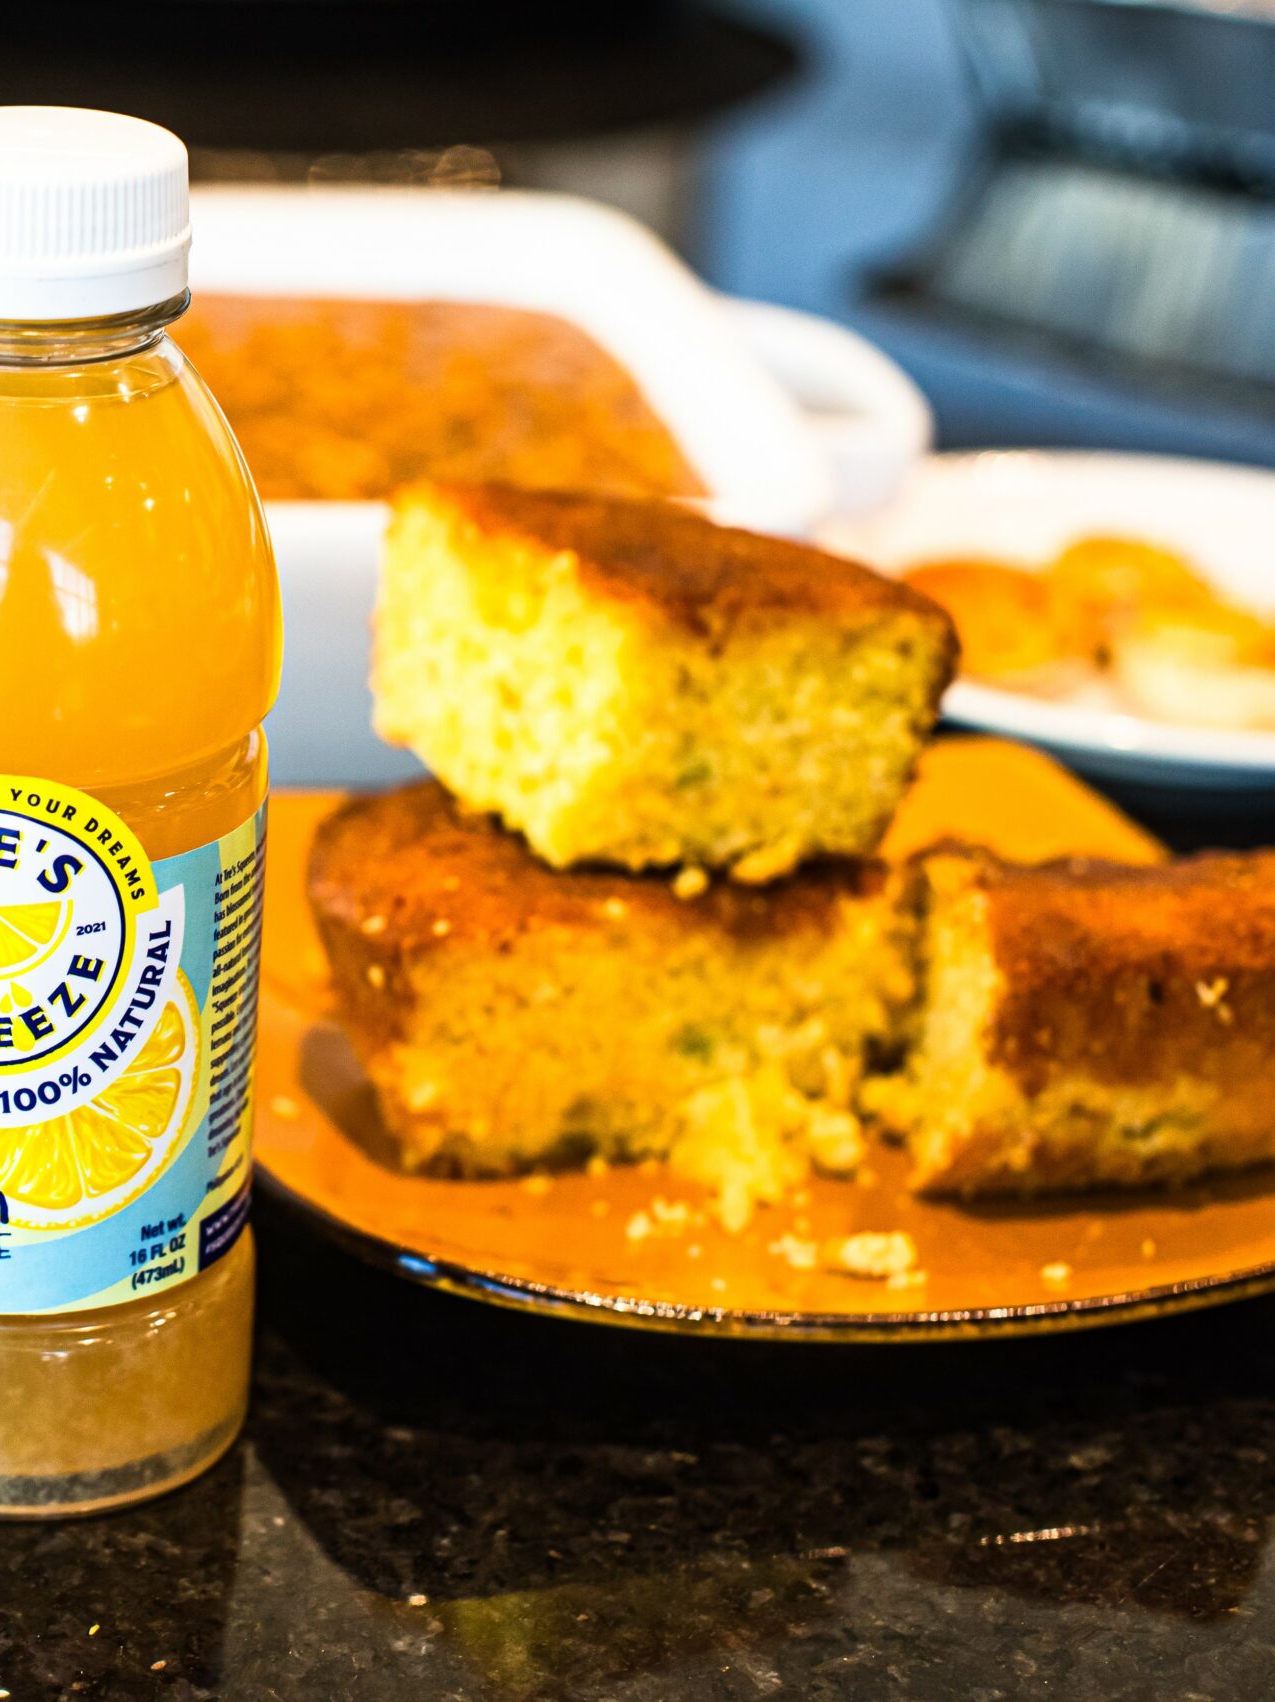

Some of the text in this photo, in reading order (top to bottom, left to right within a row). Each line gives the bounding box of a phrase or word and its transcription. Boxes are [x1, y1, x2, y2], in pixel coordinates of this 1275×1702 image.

[10, 788, 78, 821] YOUR
[84, 818, 145, 901] DREAMS
[76, 920, 106, 936] 2021
[88, 919, 173, 1073] NATURAL
[141, 1219, 165, 1242] Net
[129, 1232, 186, 1266] 16 FL OZ
[131, 1256, 186, 1291] (473mL)
